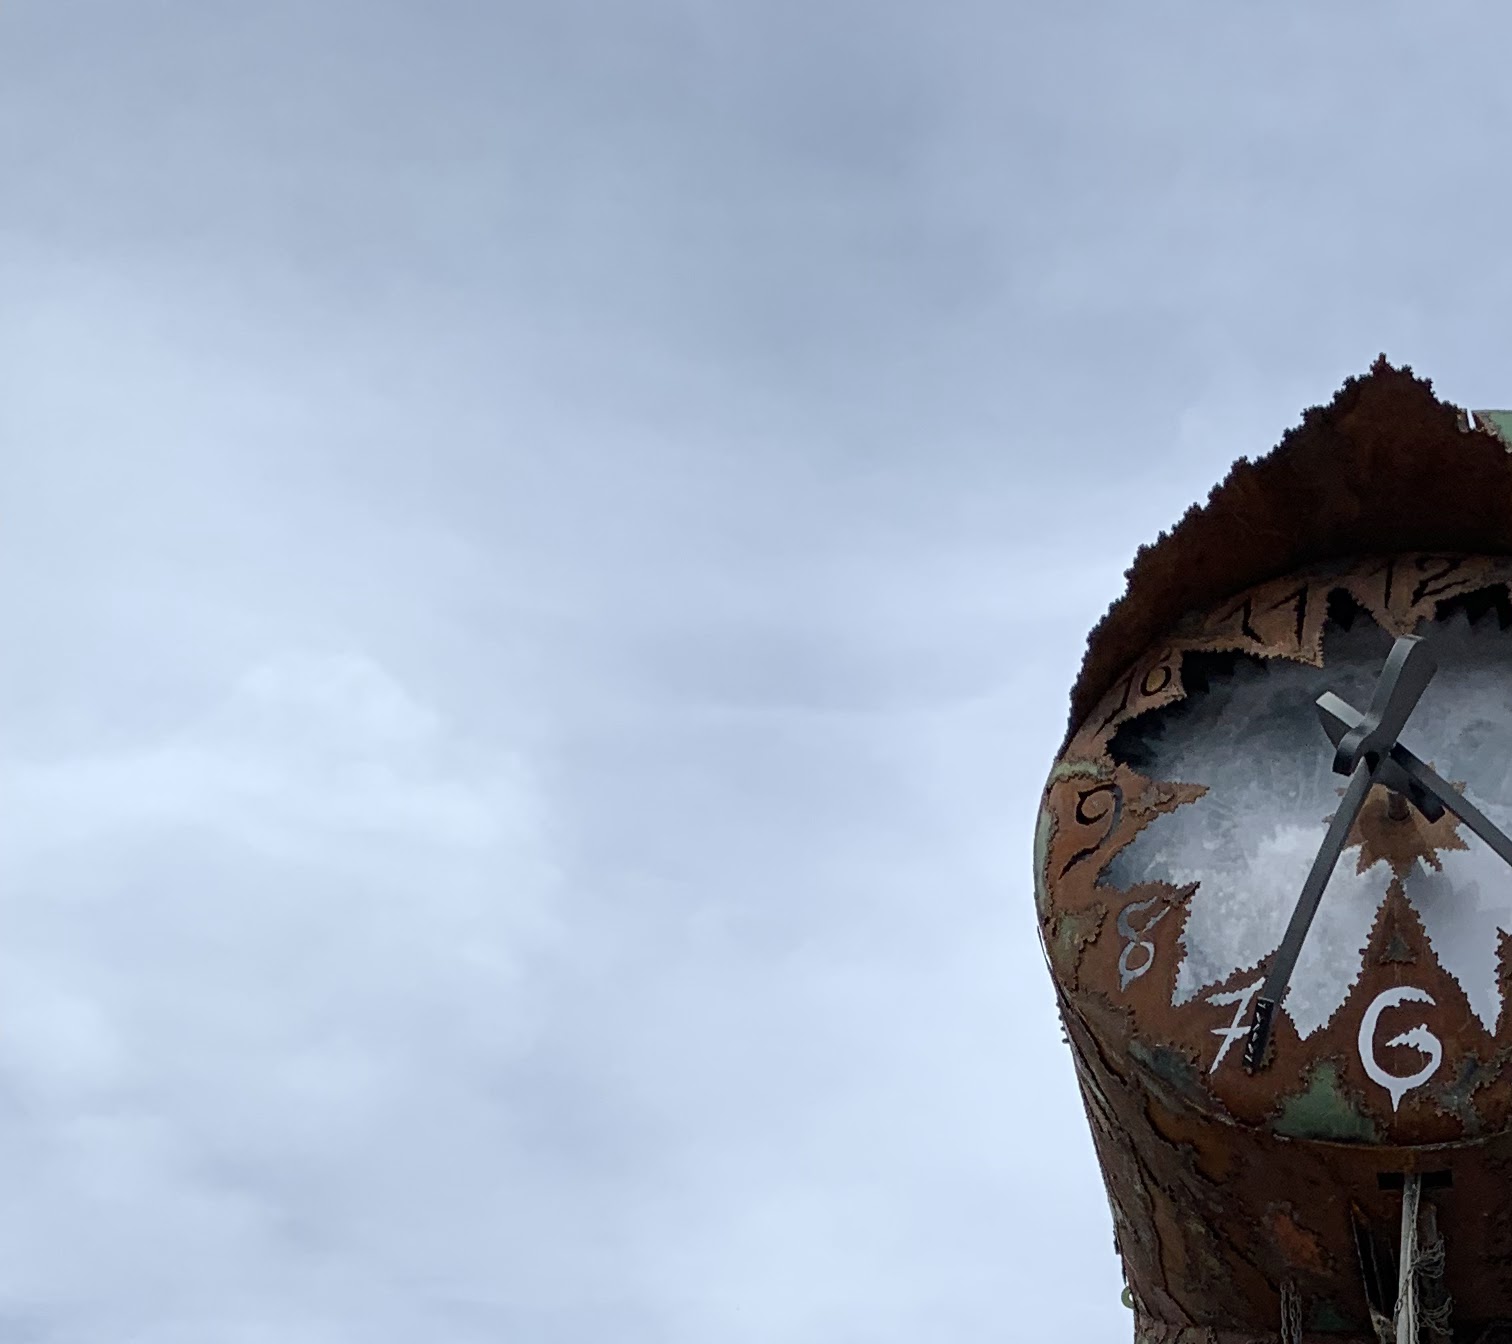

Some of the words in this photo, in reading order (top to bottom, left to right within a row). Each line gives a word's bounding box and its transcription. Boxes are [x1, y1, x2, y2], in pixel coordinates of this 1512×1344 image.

[1057, 783, 1123, 879] 9
[1116, 896, 1171, 992] 8
[1205, 976, 1266, 1075] 7
